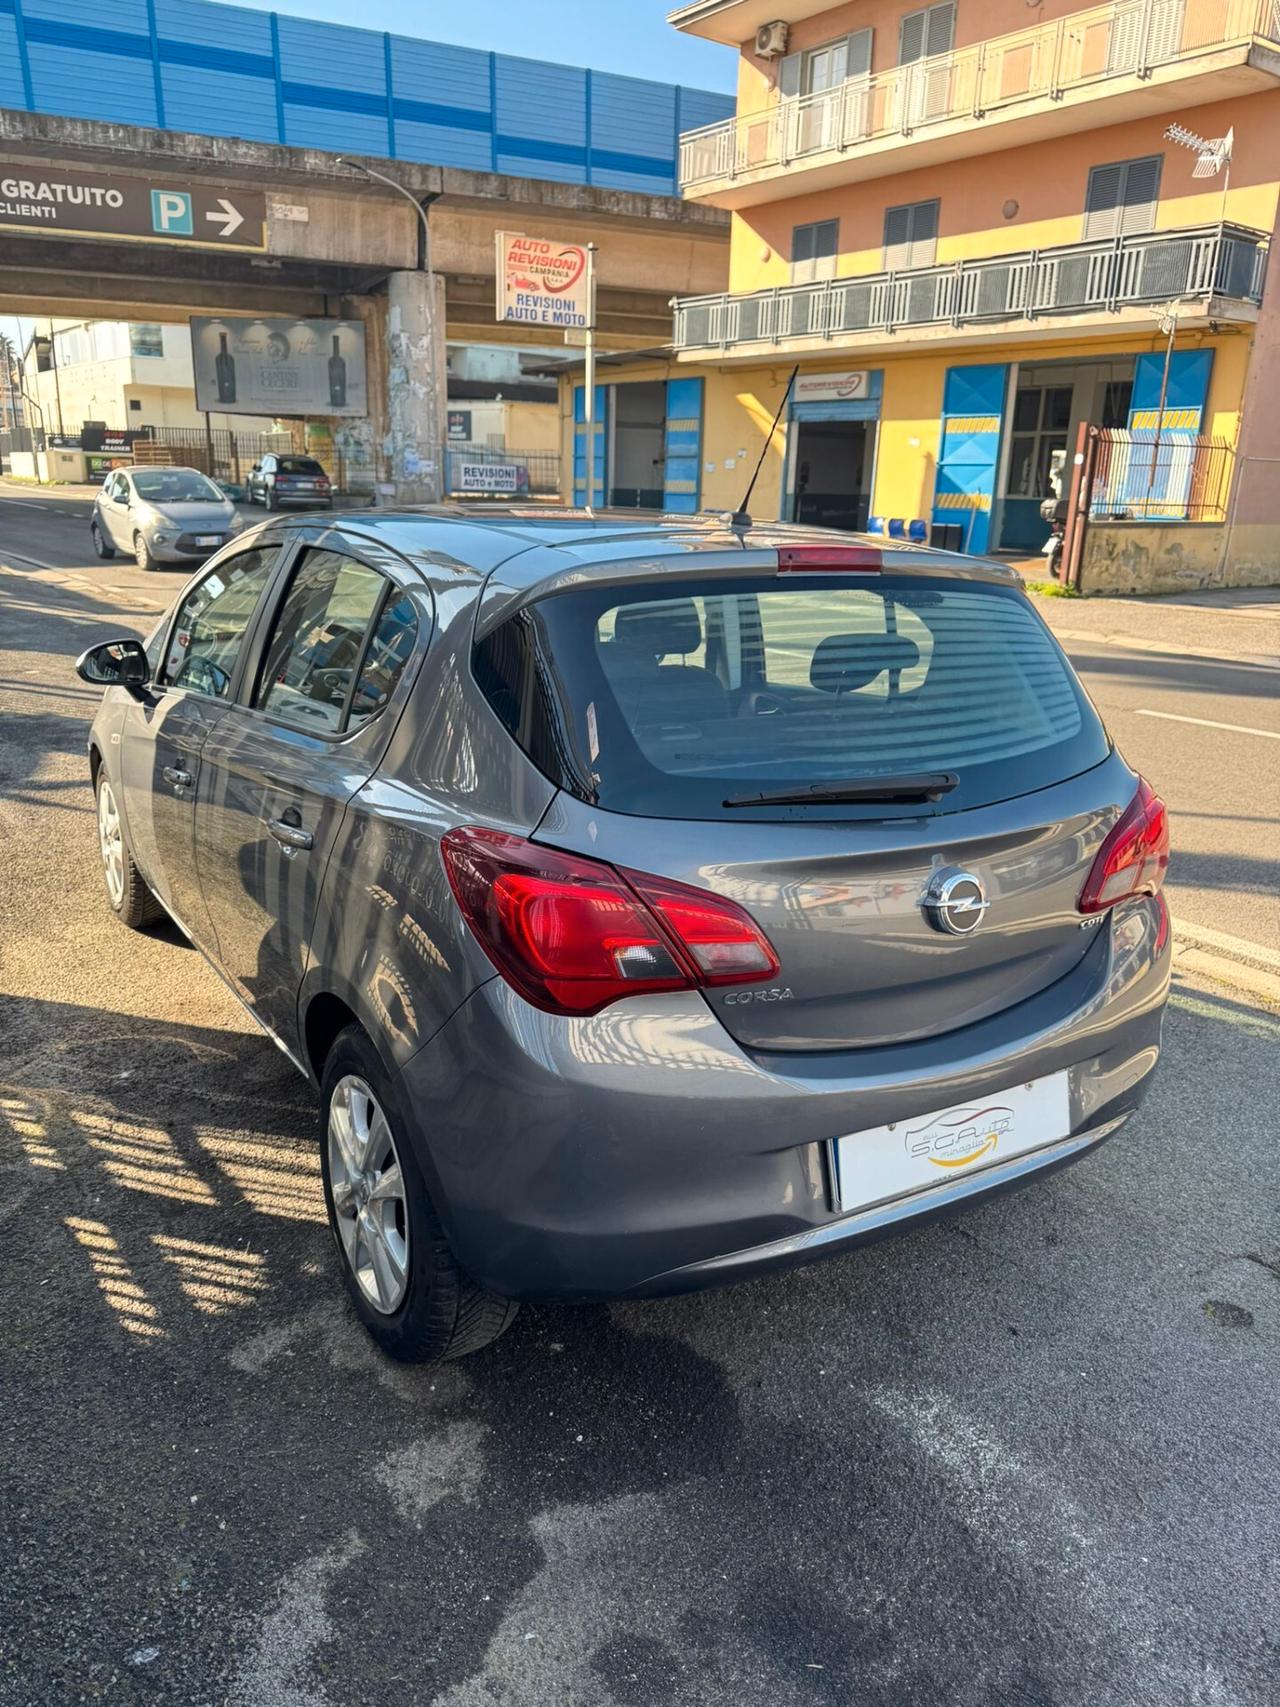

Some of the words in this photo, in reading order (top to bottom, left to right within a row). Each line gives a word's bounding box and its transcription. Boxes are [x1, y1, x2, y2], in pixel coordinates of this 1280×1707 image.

[1, 179, 124, 208] GRATUITO
[0, 202, 57, 219] CLIENTI
[159, 194, 186, 229] P
[511, 239, 551, 254] AUTO
[507, 251, 577, 271] REVISIONI
[529, 266, 570, 278] CAMPANIA
[516, 293, 576, 312] REVISIONI
[506, 305, 538, 320] AUTO
[541, 310, 549, 322] E
[552, 311, 586, 326] MOTO
[463, 466, 515, 479] REVISIONI
[463, 478, 486, 487] AUTO
[494, 480, 515, 488] MOTO
[723, 987, 795, 1005] CORSA
